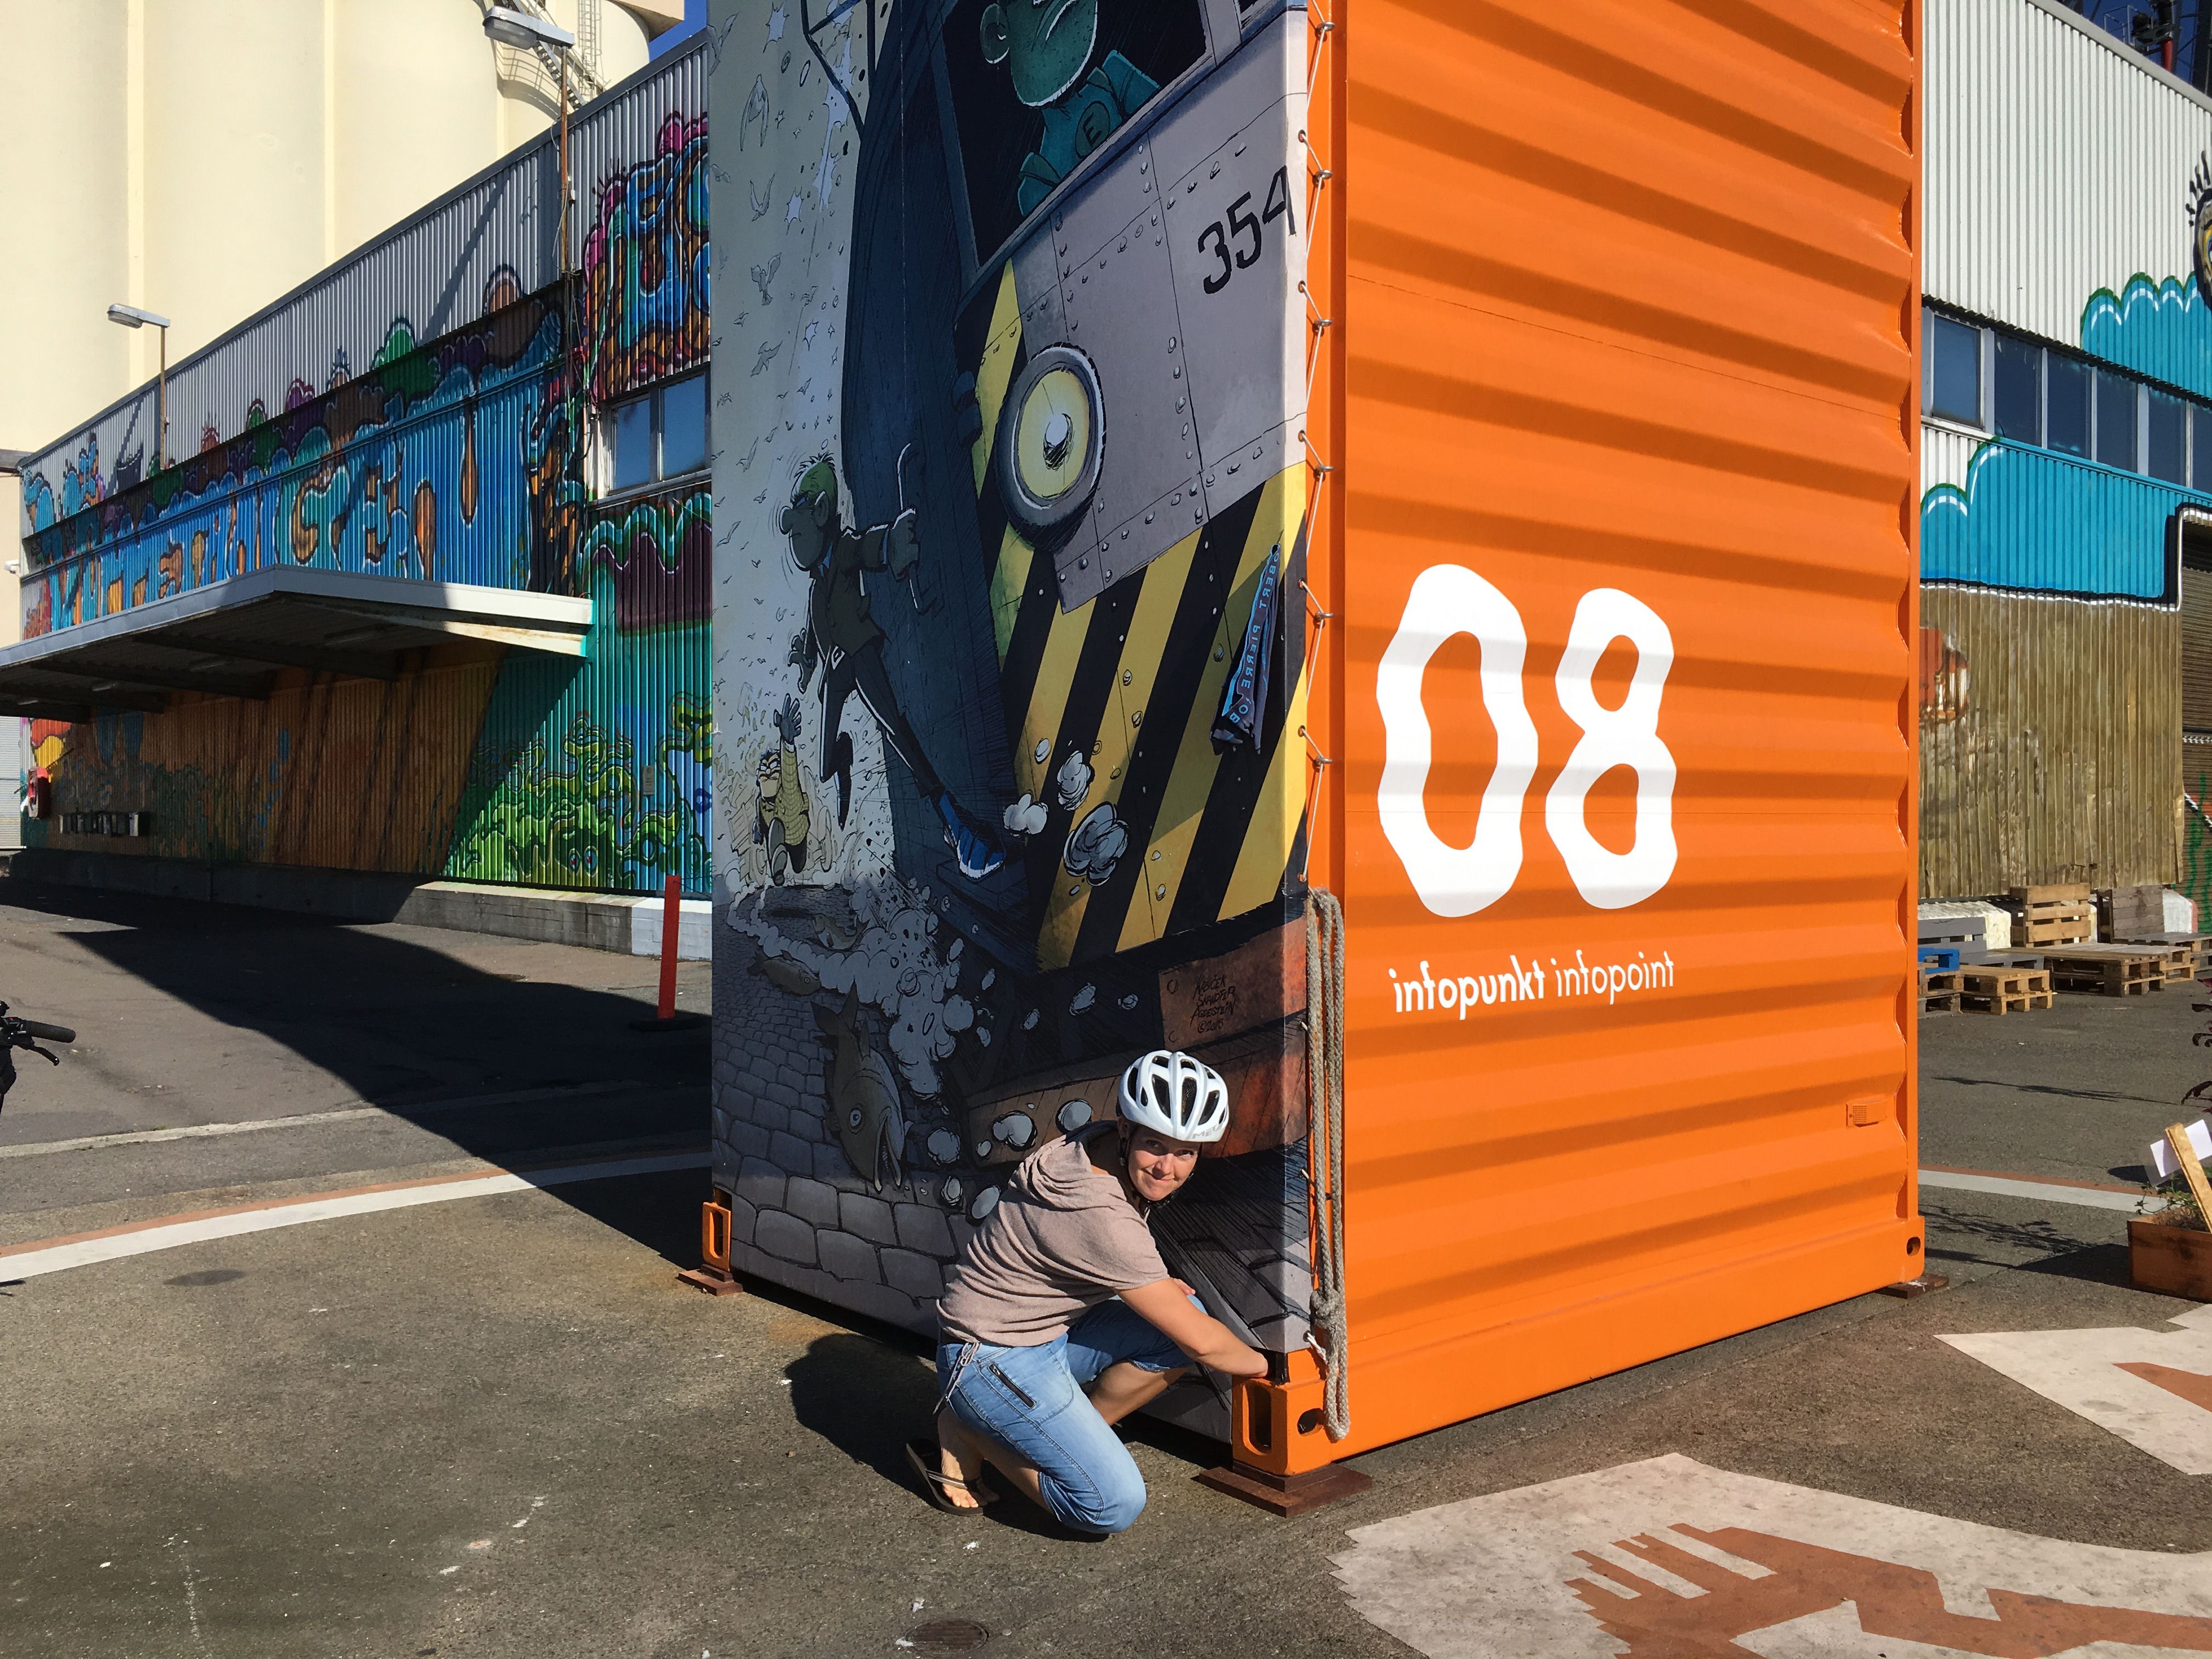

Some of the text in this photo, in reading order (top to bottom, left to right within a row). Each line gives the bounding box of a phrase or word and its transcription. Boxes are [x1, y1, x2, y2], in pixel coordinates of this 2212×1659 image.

[1083, 112, 1102, 148] E
[1198, 165, 1297, 295] 354
[1376, 564, 1678, 917] 08
[1389, 950, 1674, 1020] infopunkt infopoint
[1192, 1124, 1217, 1139] MET
